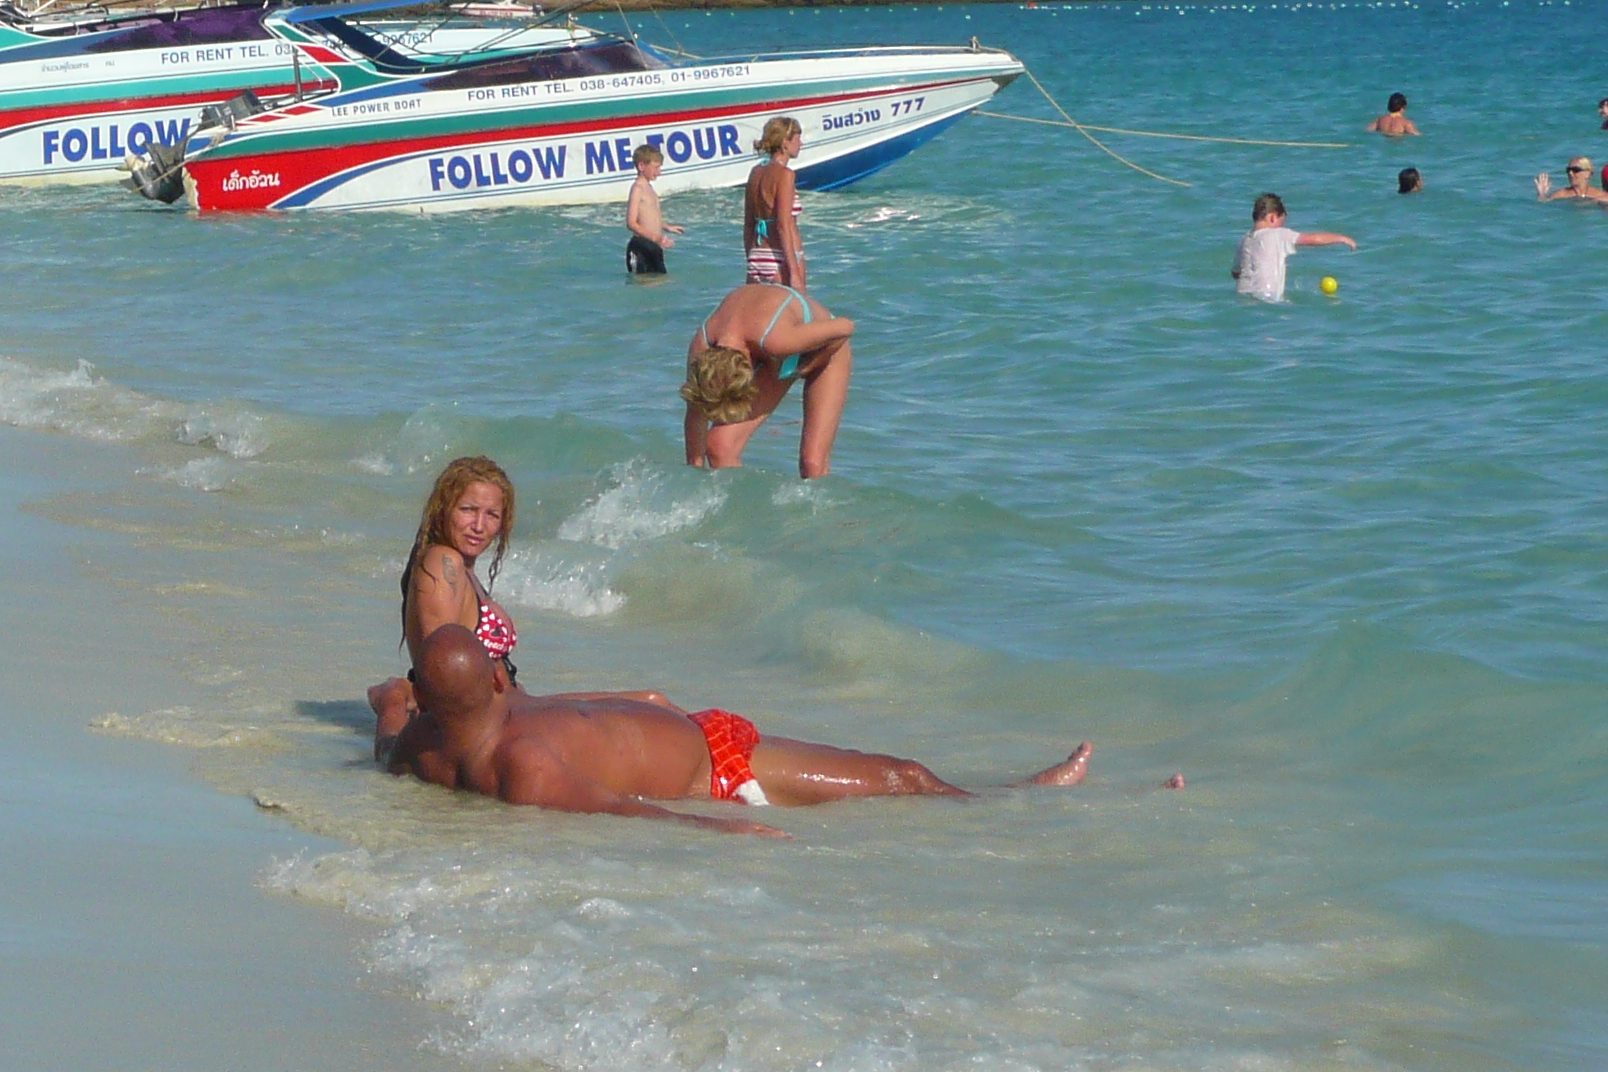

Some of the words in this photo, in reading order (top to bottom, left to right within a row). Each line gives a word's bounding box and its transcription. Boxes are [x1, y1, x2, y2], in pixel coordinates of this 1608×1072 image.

[161, 52, 190, 64] FOR
[196, 48, 233, 62] RENT
[239, 45, 269, 58] TEL.
[467, 90, 496, 101] FOR
[501, 85, 538, 98] RENT
[543, 82, 574, 94] TEL.
[671, 65, 751, 83] 01-9967621
[331, 106, 349, 117] LEE
[353, 102, 390, 115] POWER
[394, 99, 422, 110] BOAT
[891, 97, 925, 116] 777
[43, 118, 191, 165] FOLLOW
[428, 145, 567, 191] FOLLOW
[585, 137, 635, 174] ME
[646, 124, 743, 163] TOUR
[222, 169, 280, 191] เด็กอ้วน
